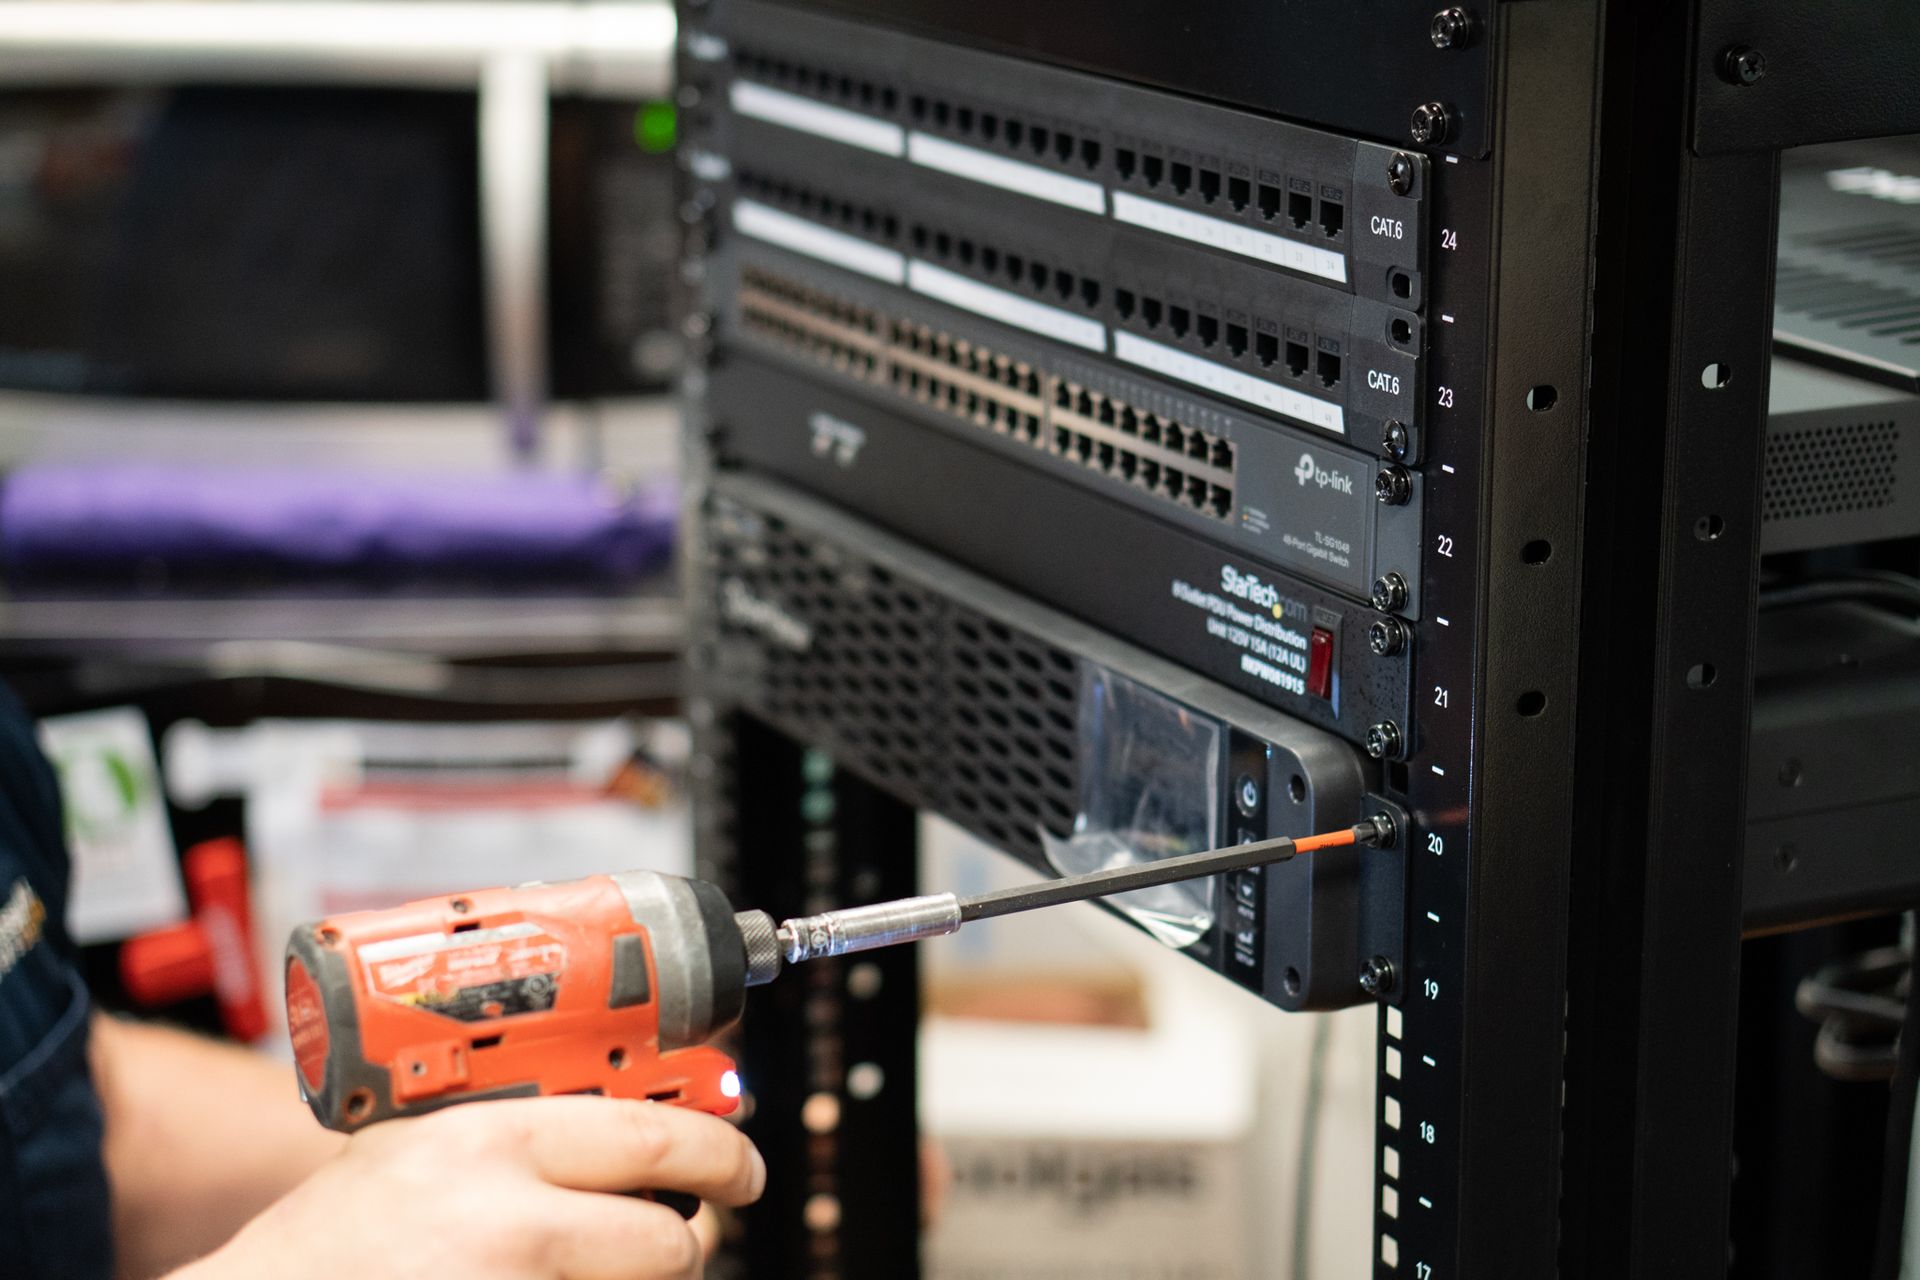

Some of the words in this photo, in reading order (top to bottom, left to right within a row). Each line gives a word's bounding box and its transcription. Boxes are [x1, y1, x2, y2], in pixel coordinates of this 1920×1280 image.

[1371, 216, 1403, 240] CAT.6
[1441, 229, 1457, 251] 24
[1367, 370, 1400, 395] CAT.6
[1438, 386, 1454, 408] 23
[1315, 466, 1353, 495] tp-link
[1437, 534, 1453, 557] 22
[1254, 614, 1307, 650] Distribution
[1434, 686, 1449, 708] 21
[1428, 833, 1443, 855] 20
[1424, 978, 1439, 1000] 19
[1420, 1121, 1435, 1144] 18
[1416, 1261, 1431, 1280] 17
